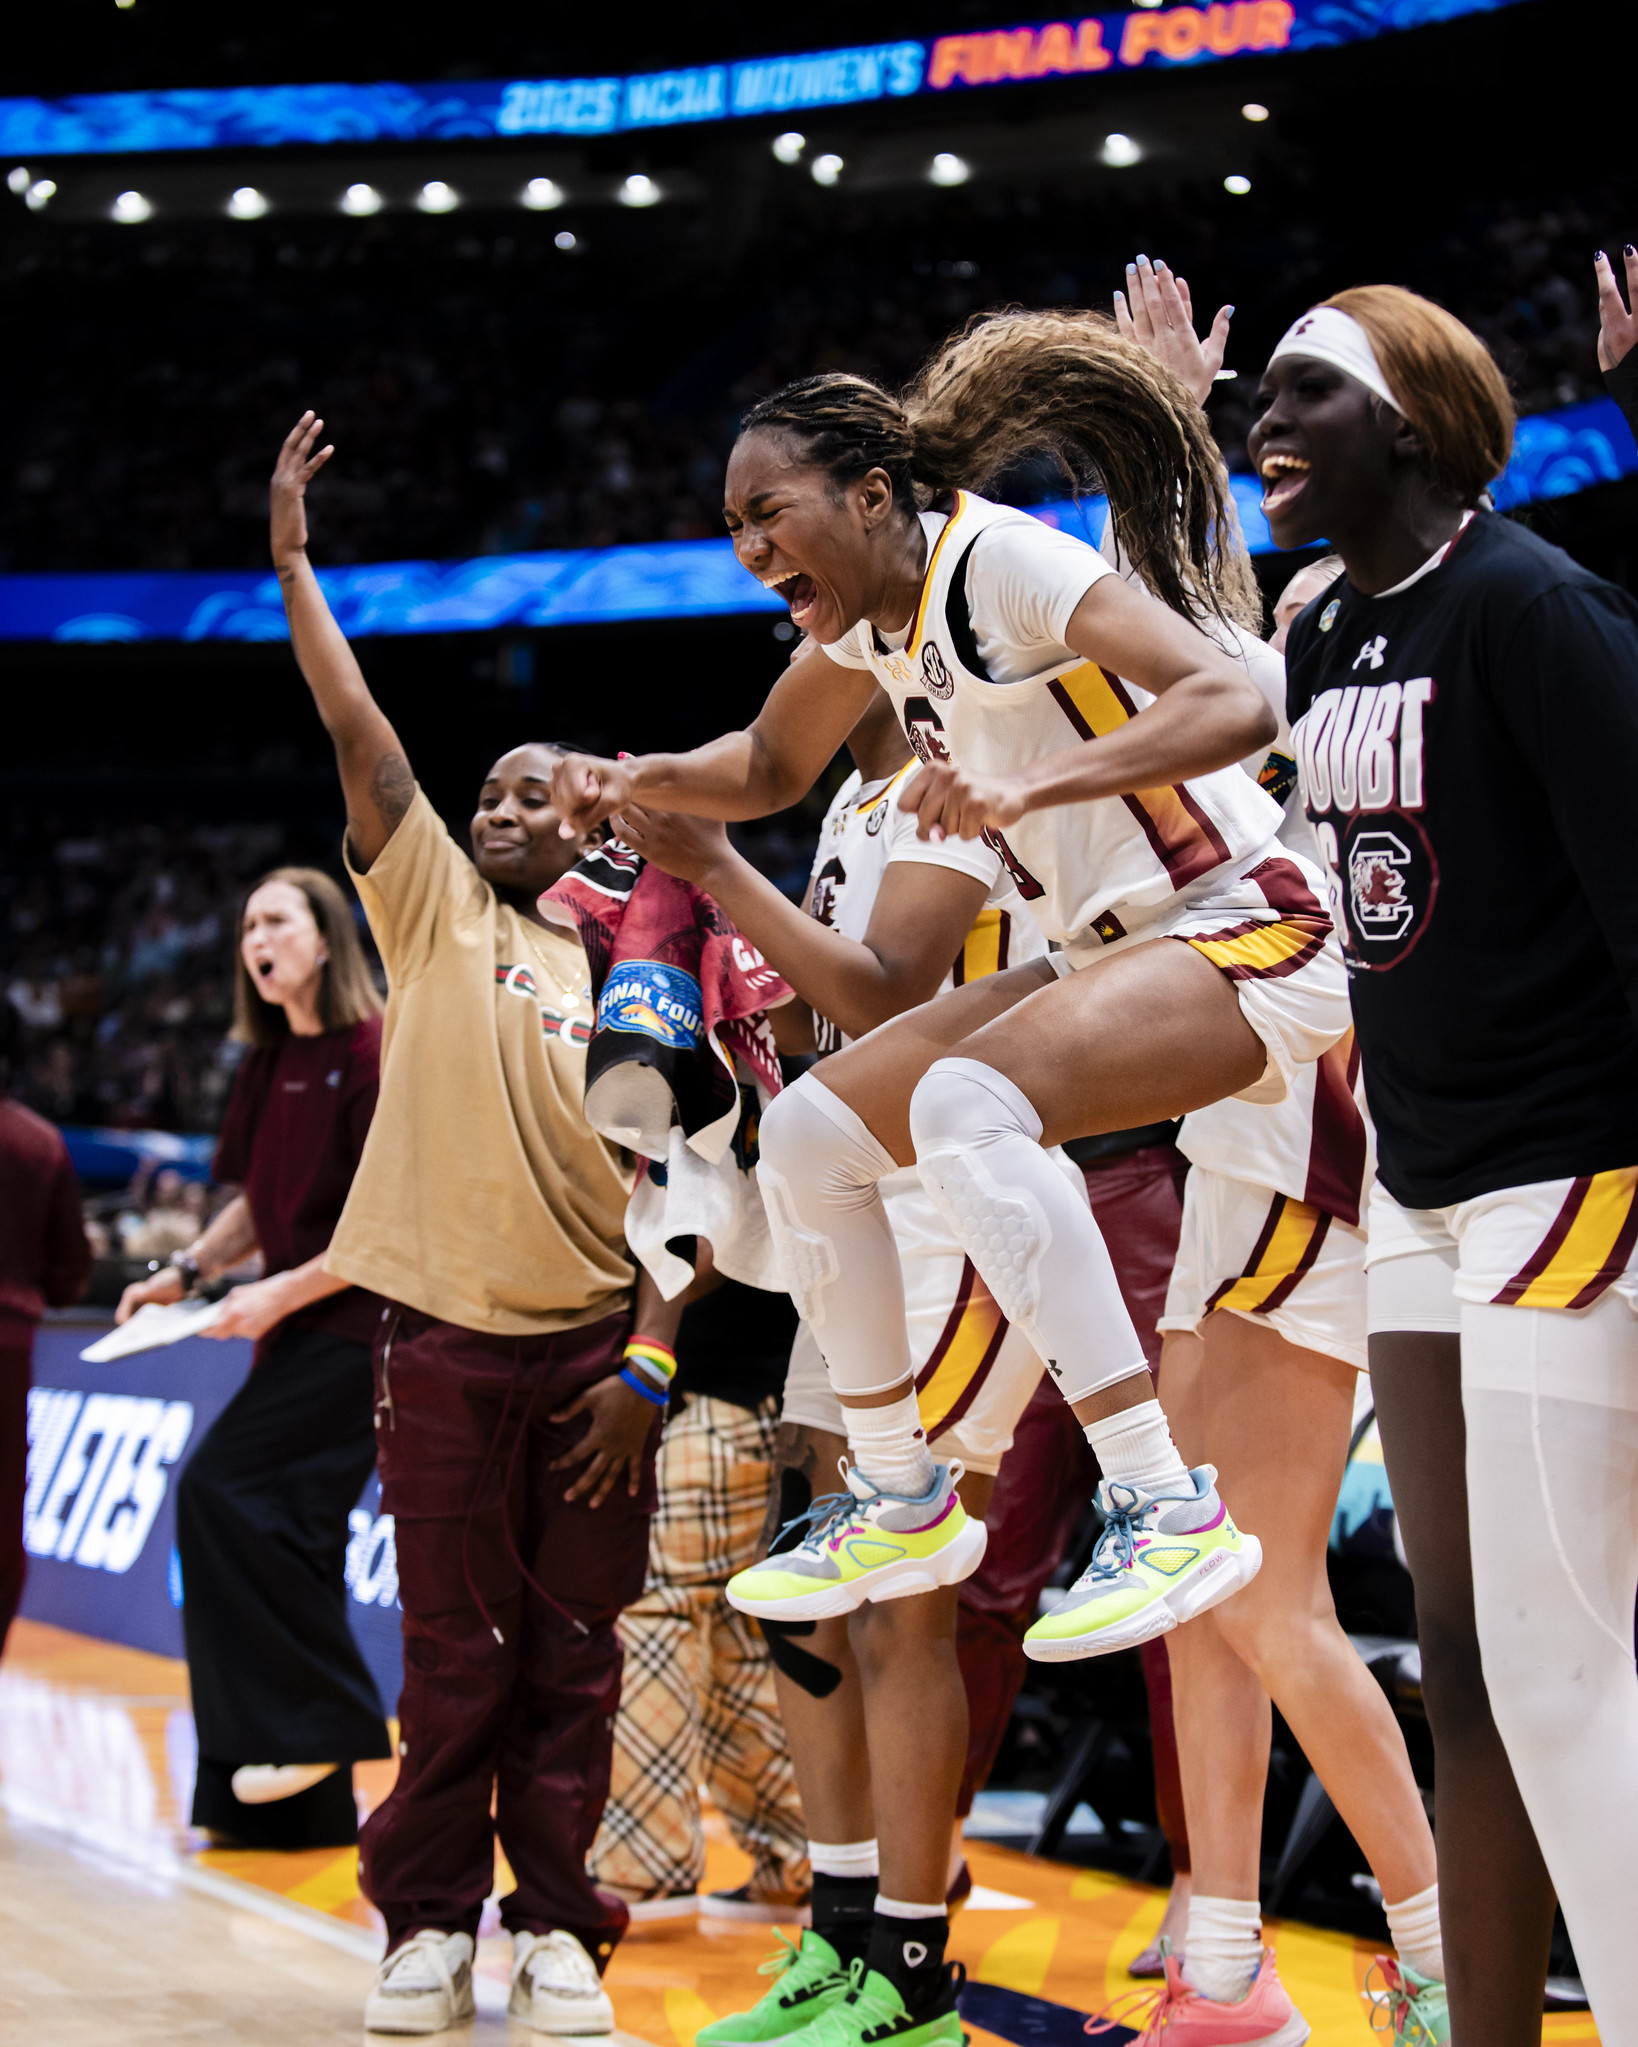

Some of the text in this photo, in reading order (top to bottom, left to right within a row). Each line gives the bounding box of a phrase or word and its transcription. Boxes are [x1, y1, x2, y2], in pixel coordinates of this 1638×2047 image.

[928, 19, 1113, 89] FINAL
[1119, 0, 1296, 65] FOUR
[601, 982, 652, 1016] FINAL
[1199, 1553, 1222, 1576] FLOW
